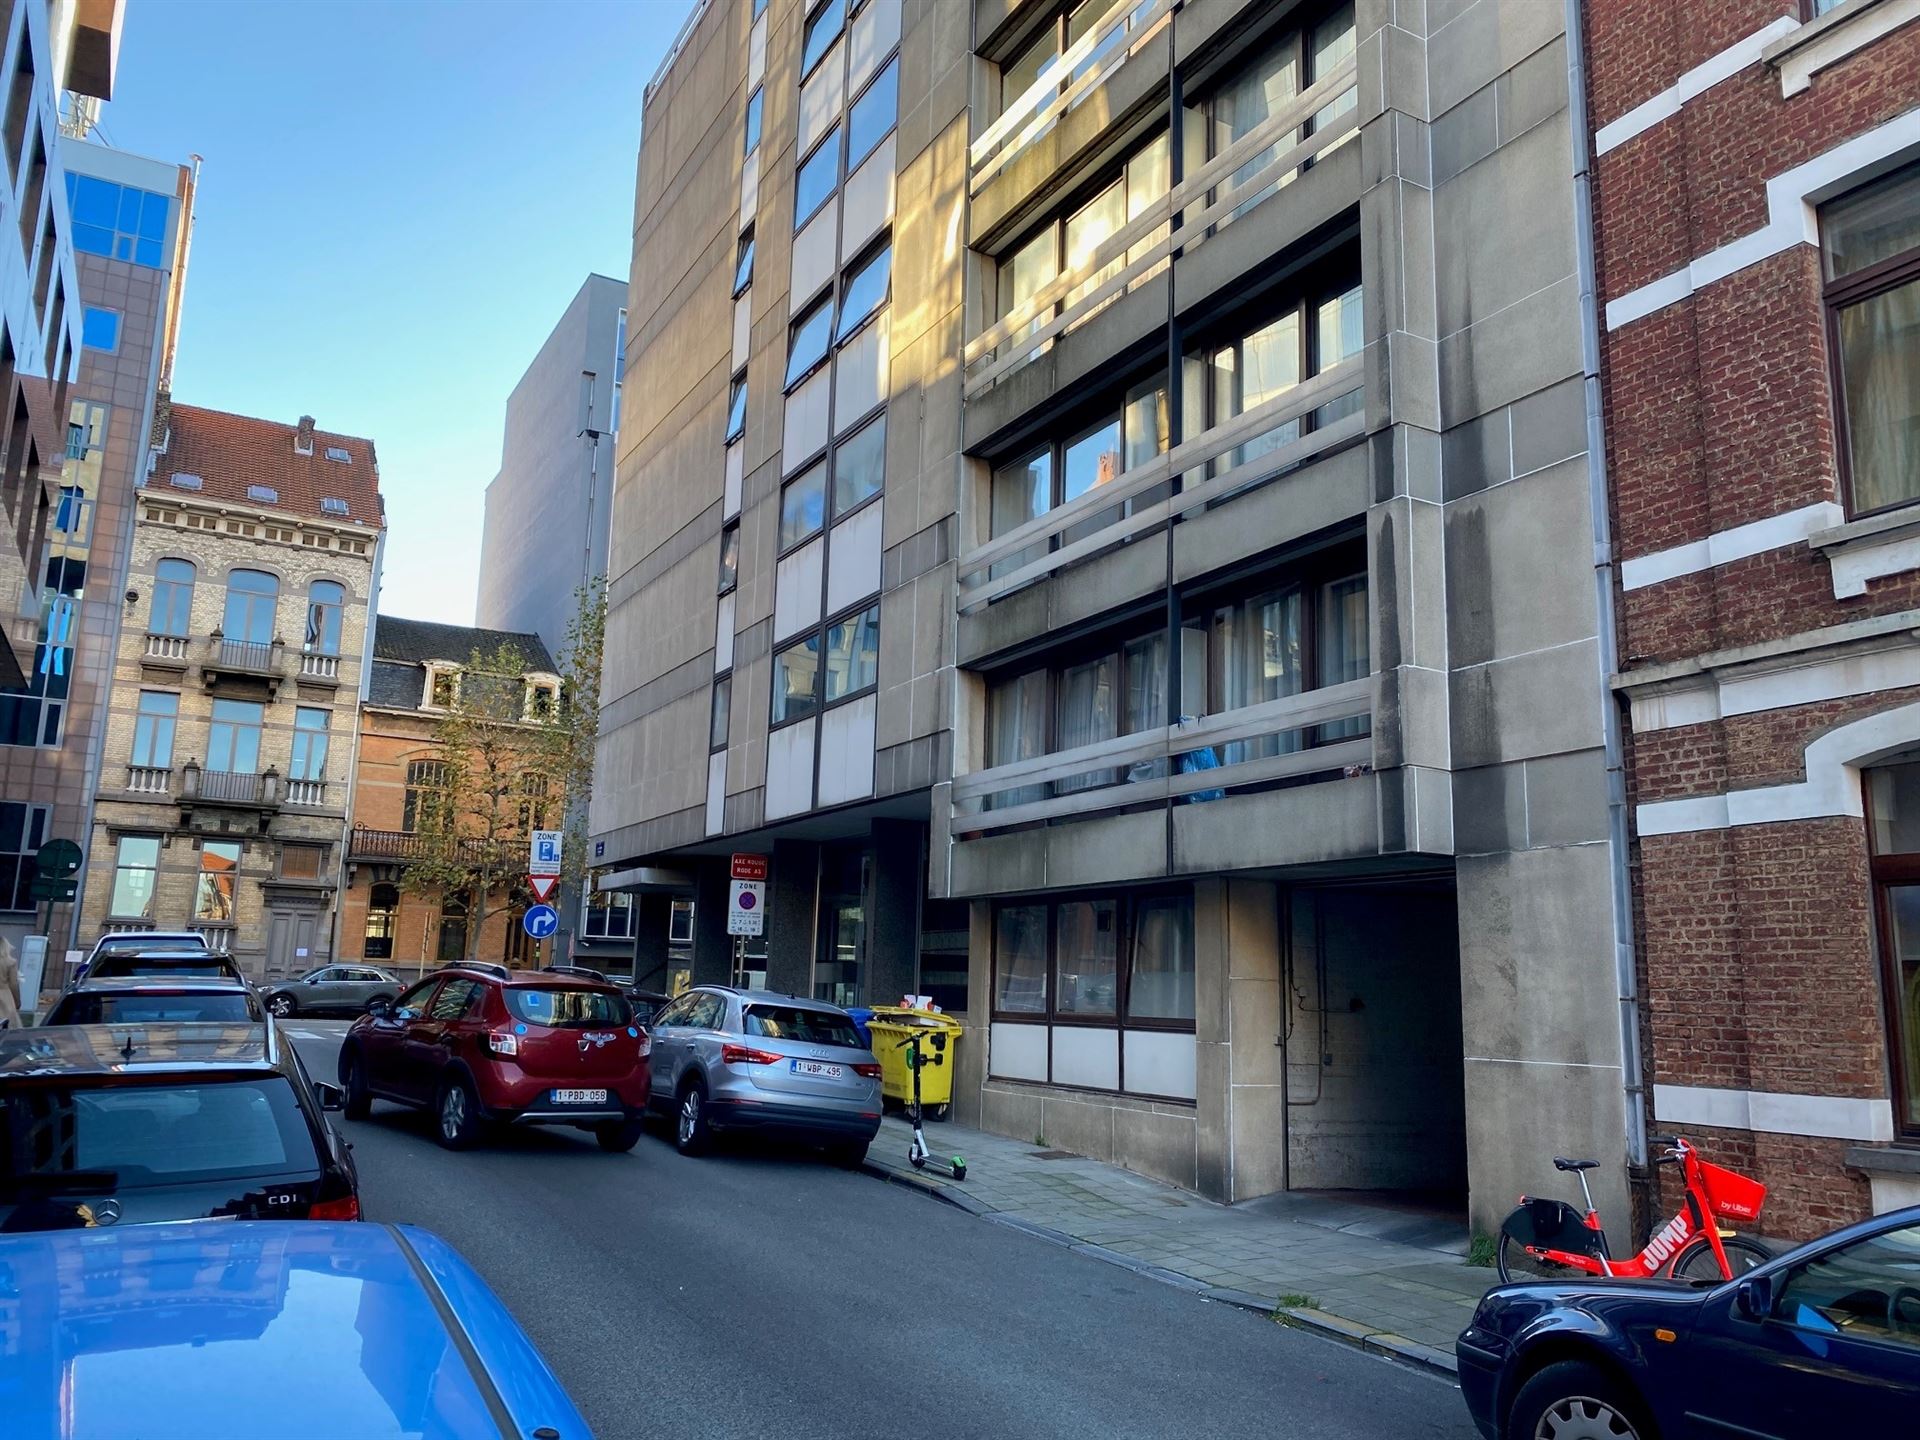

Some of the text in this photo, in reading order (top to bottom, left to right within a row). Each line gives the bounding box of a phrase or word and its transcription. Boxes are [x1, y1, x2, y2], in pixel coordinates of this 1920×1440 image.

[542, 842, 551, 853] P
[558, 1090, 606, 1101] 1-PBD-058
[268, 1194, 297, 1205] CDI
[1720, 1200, 1752, 1214] by Uber
[1643, 1214, 1690, 1271] JUMP
